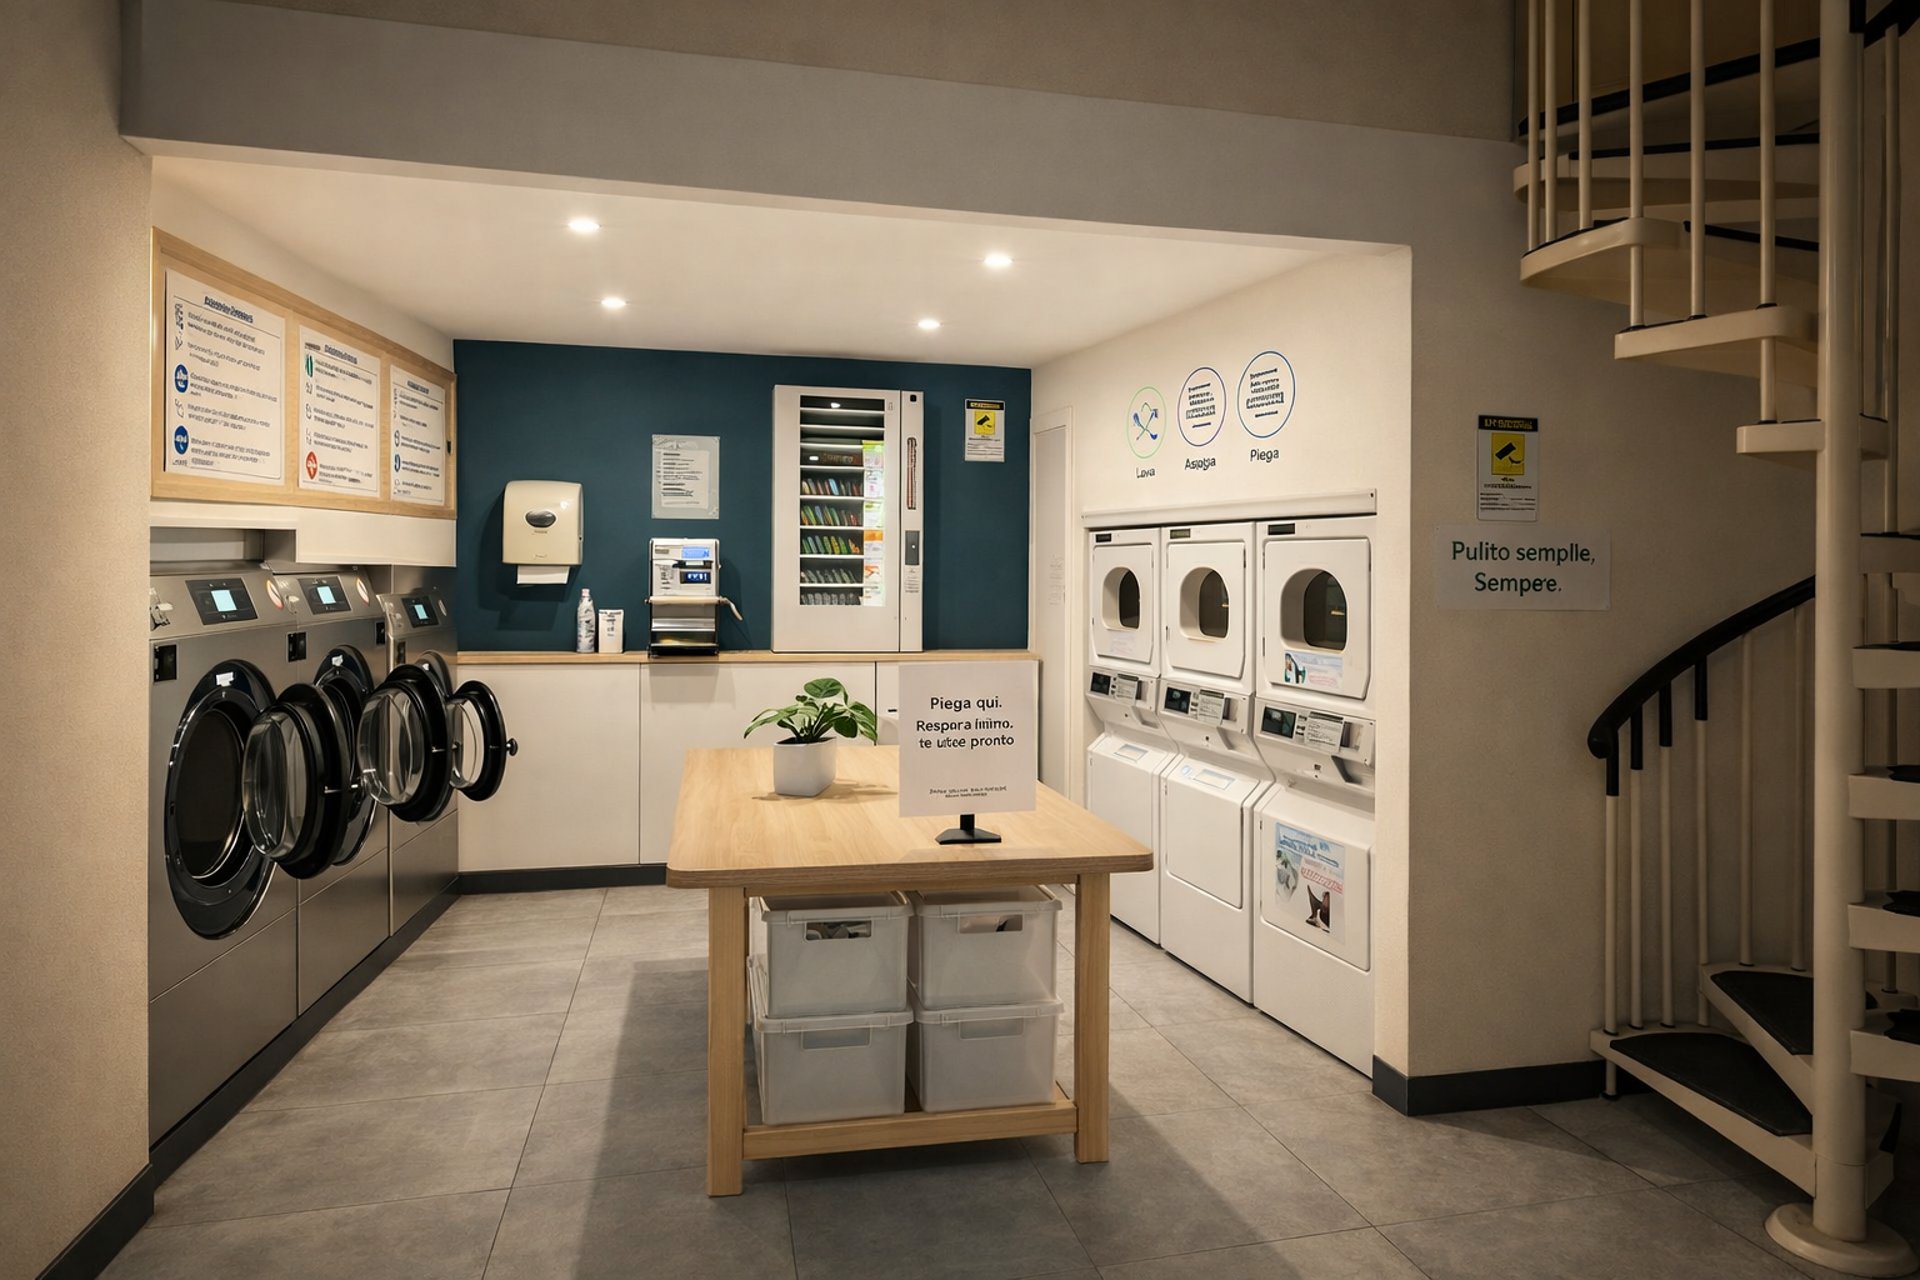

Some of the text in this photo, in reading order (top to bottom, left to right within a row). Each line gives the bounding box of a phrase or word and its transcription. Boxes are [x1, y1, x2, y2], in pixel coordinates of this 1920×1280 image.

[1250, 449, 1280, 464] Piega
[1452, 540, 1510, 561] Pulito
[930, 696, 1002, 712] Piega qui.
[919, 738, 932, 748] te
[970, 735, 1014, 750] pronto
